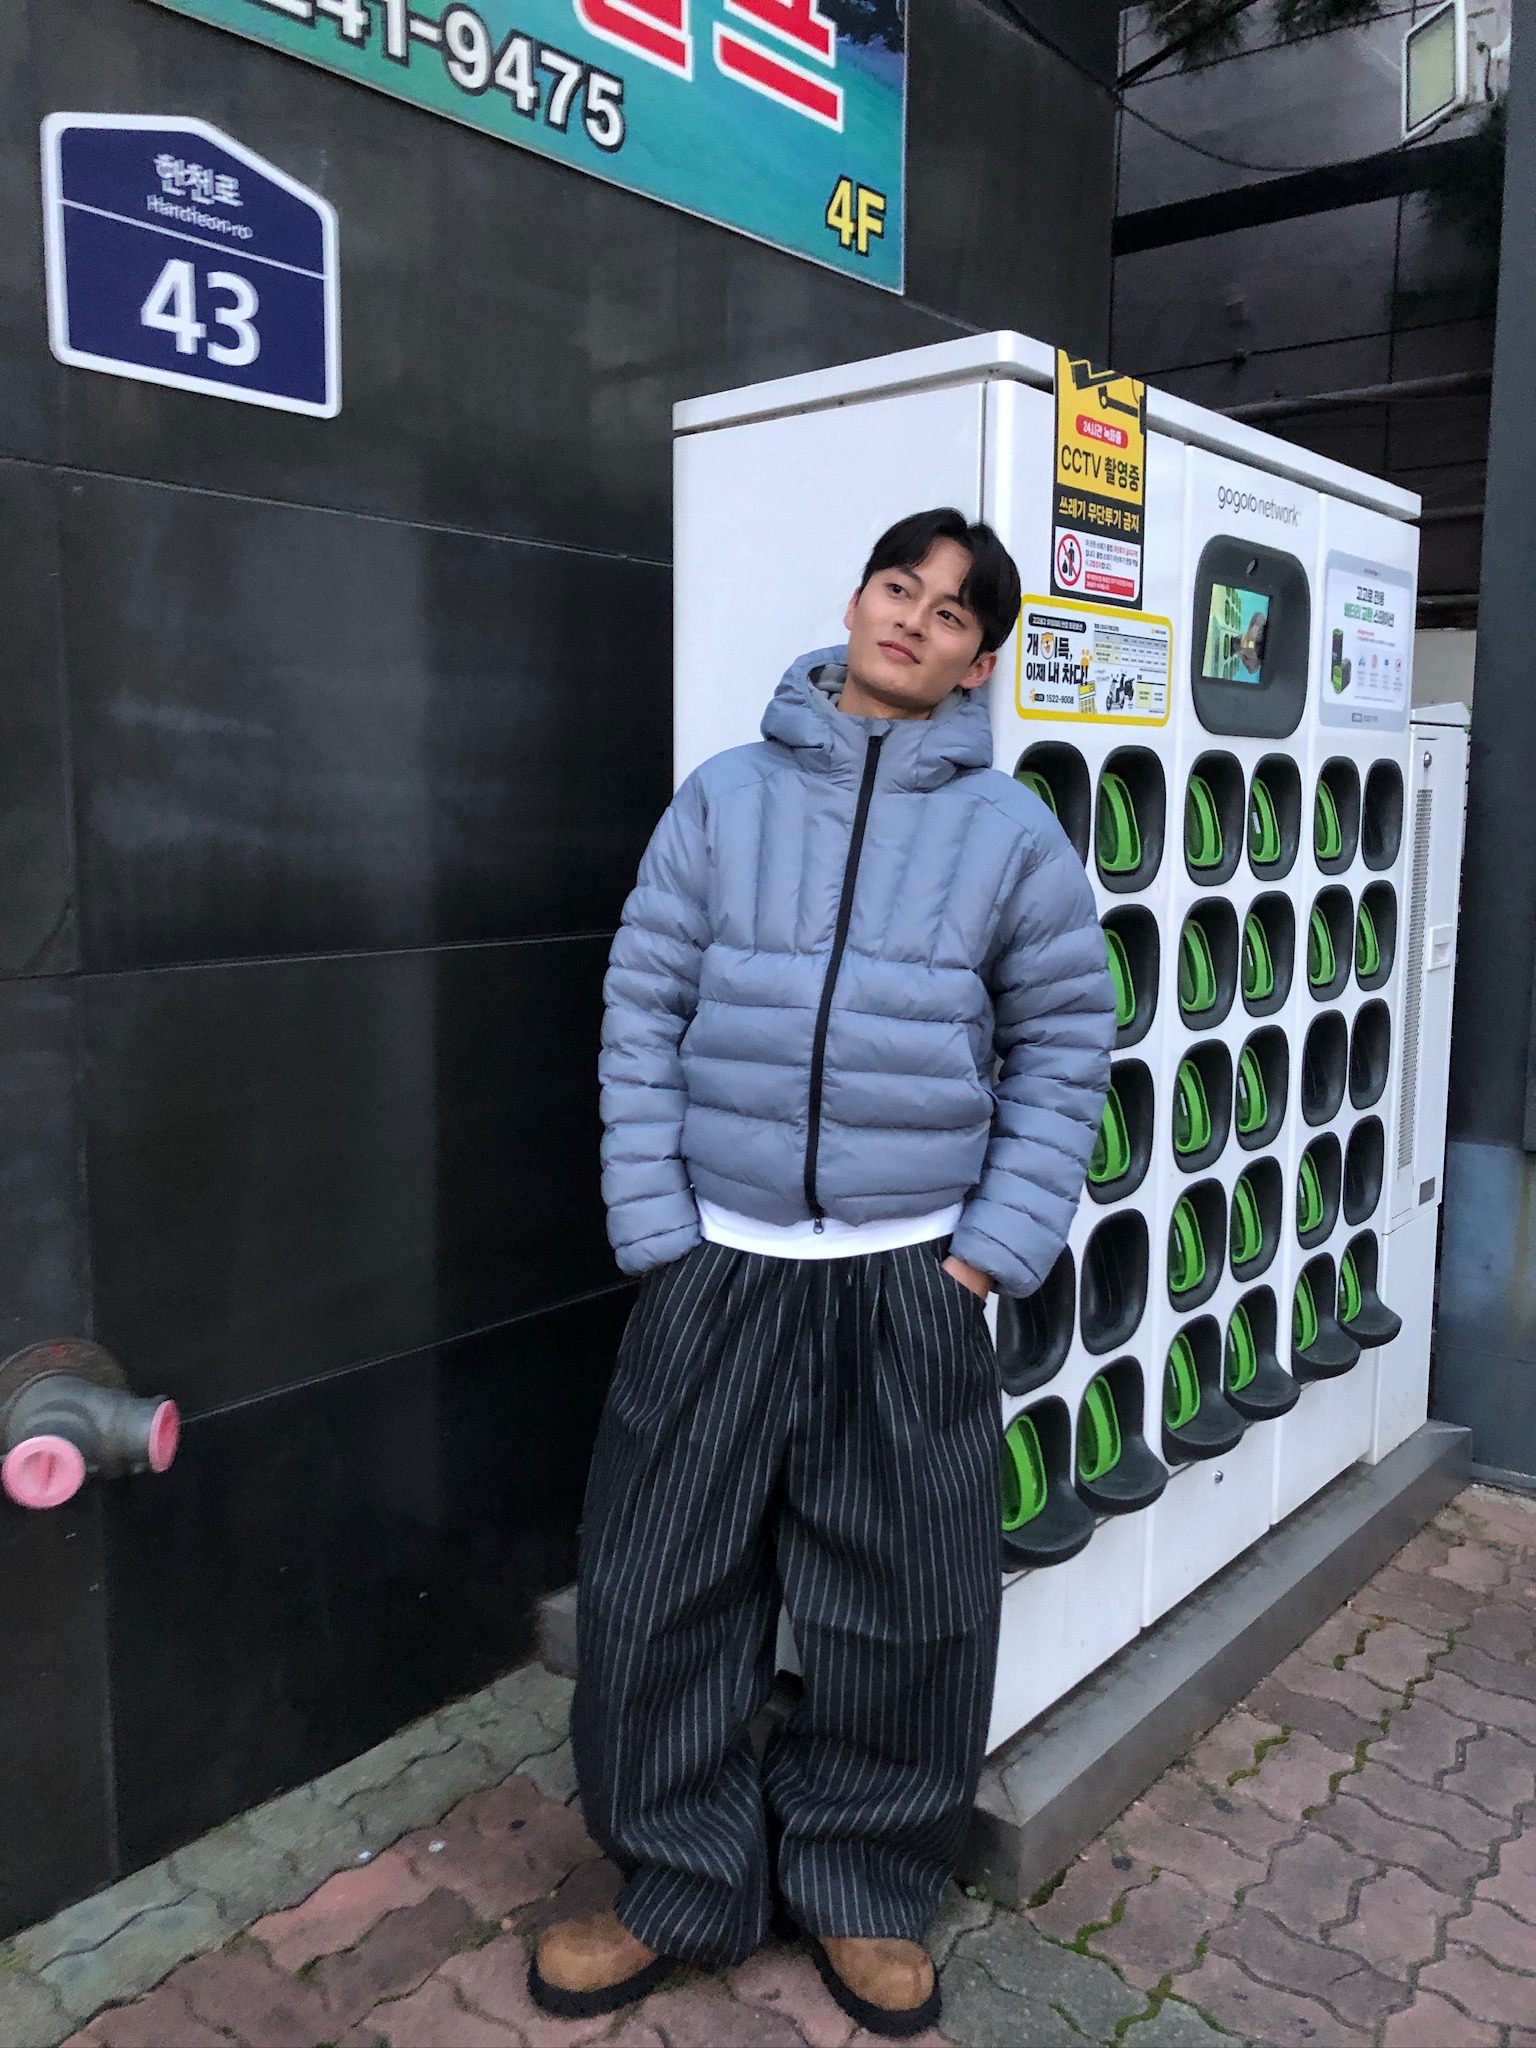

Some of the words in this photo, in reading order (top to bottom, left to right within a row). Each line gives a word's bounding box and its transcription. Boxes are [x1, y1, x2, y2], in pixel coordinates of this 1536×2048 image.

[153, 153, 245, 207] 한천로
[146, 194, 254, 240] Hancheon-ro
[825, 174, 887, 256] 4F
[138, 258, 263, 367] 43
[1083, 420, 1103, 439] 24시간
[1061, 444, 1102, 478] CCTV
[1104, 456, 1140, 492] 촬영중
[1058, 495, 1087, 521] 쓰레기
[1087, 502, 1122, 529] 무단투기
[1123, 511, 1140, 533] 금지
[1026, 662, 1046, 682] 이제
[1048, 661, 1059, 683] 내
[1061, 663, 1089, 686] 차다!
[1046, 694, 1074, 705] 1522-9008
